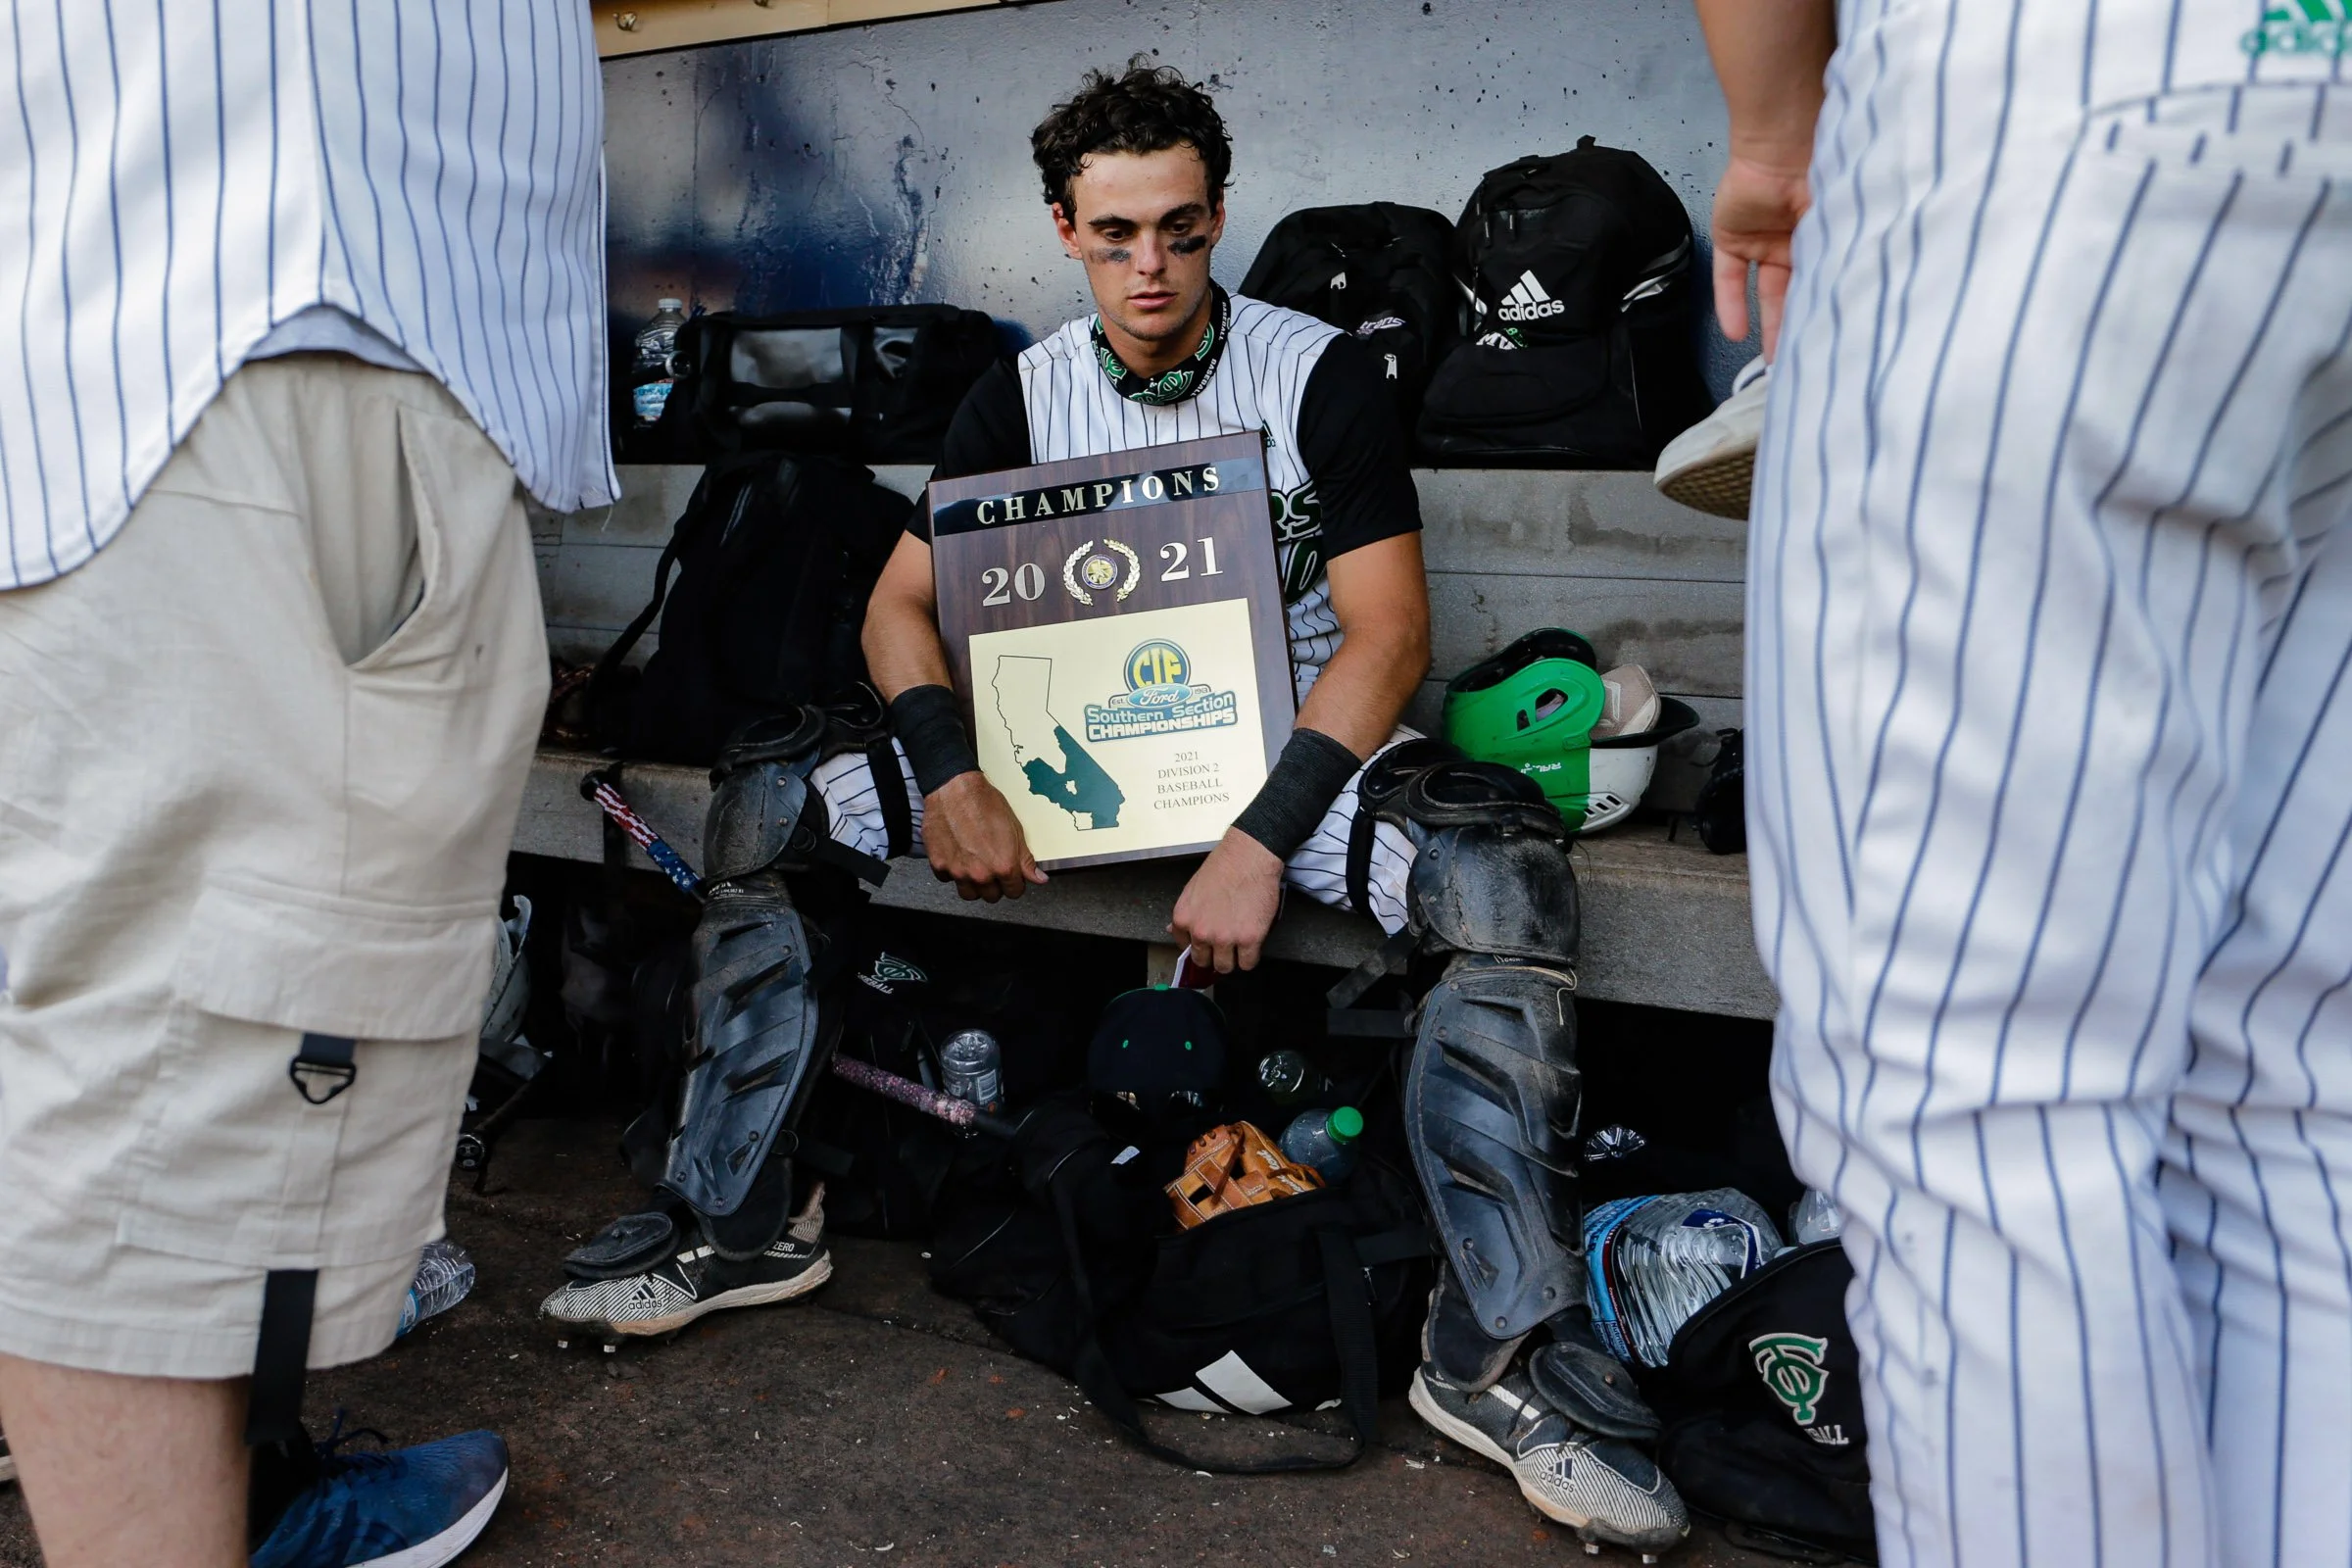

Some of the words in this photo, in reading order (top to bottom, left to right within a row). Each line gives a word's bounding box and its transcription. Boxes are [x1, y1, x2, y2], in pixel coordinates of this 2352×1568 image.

[1497, 299, 1565, 321] adidas
[977, 466, 1220, 525] CHAMPIONS
[982, 563, 1046, 607] 20
[1160, 537, 1224, 582] 21
[1133, 648, 1182, 688] CIF
[1087, 708, 1164, 723] Southern
[1172, 693, 1233, 718] Section
[1140, 688, 1180, 706] Ford
[1088, 707, 1236, 740] CHAMPIONSHIPS
[1175, 751, 1199, 762] 2021
[1158, 763, 1210, 779] DIVISION
[1213, 762, 1220, 772] 2
[1157, 778, 1223, 794] BASEBALL
[1153, 792, 1230, 809] CHAMPIONS
[628, 1298, 662, 1310] adidas
[1611, 1322, 1627, 1354] Nutrition
[1540, 1470, 1575, 1493] adidas
